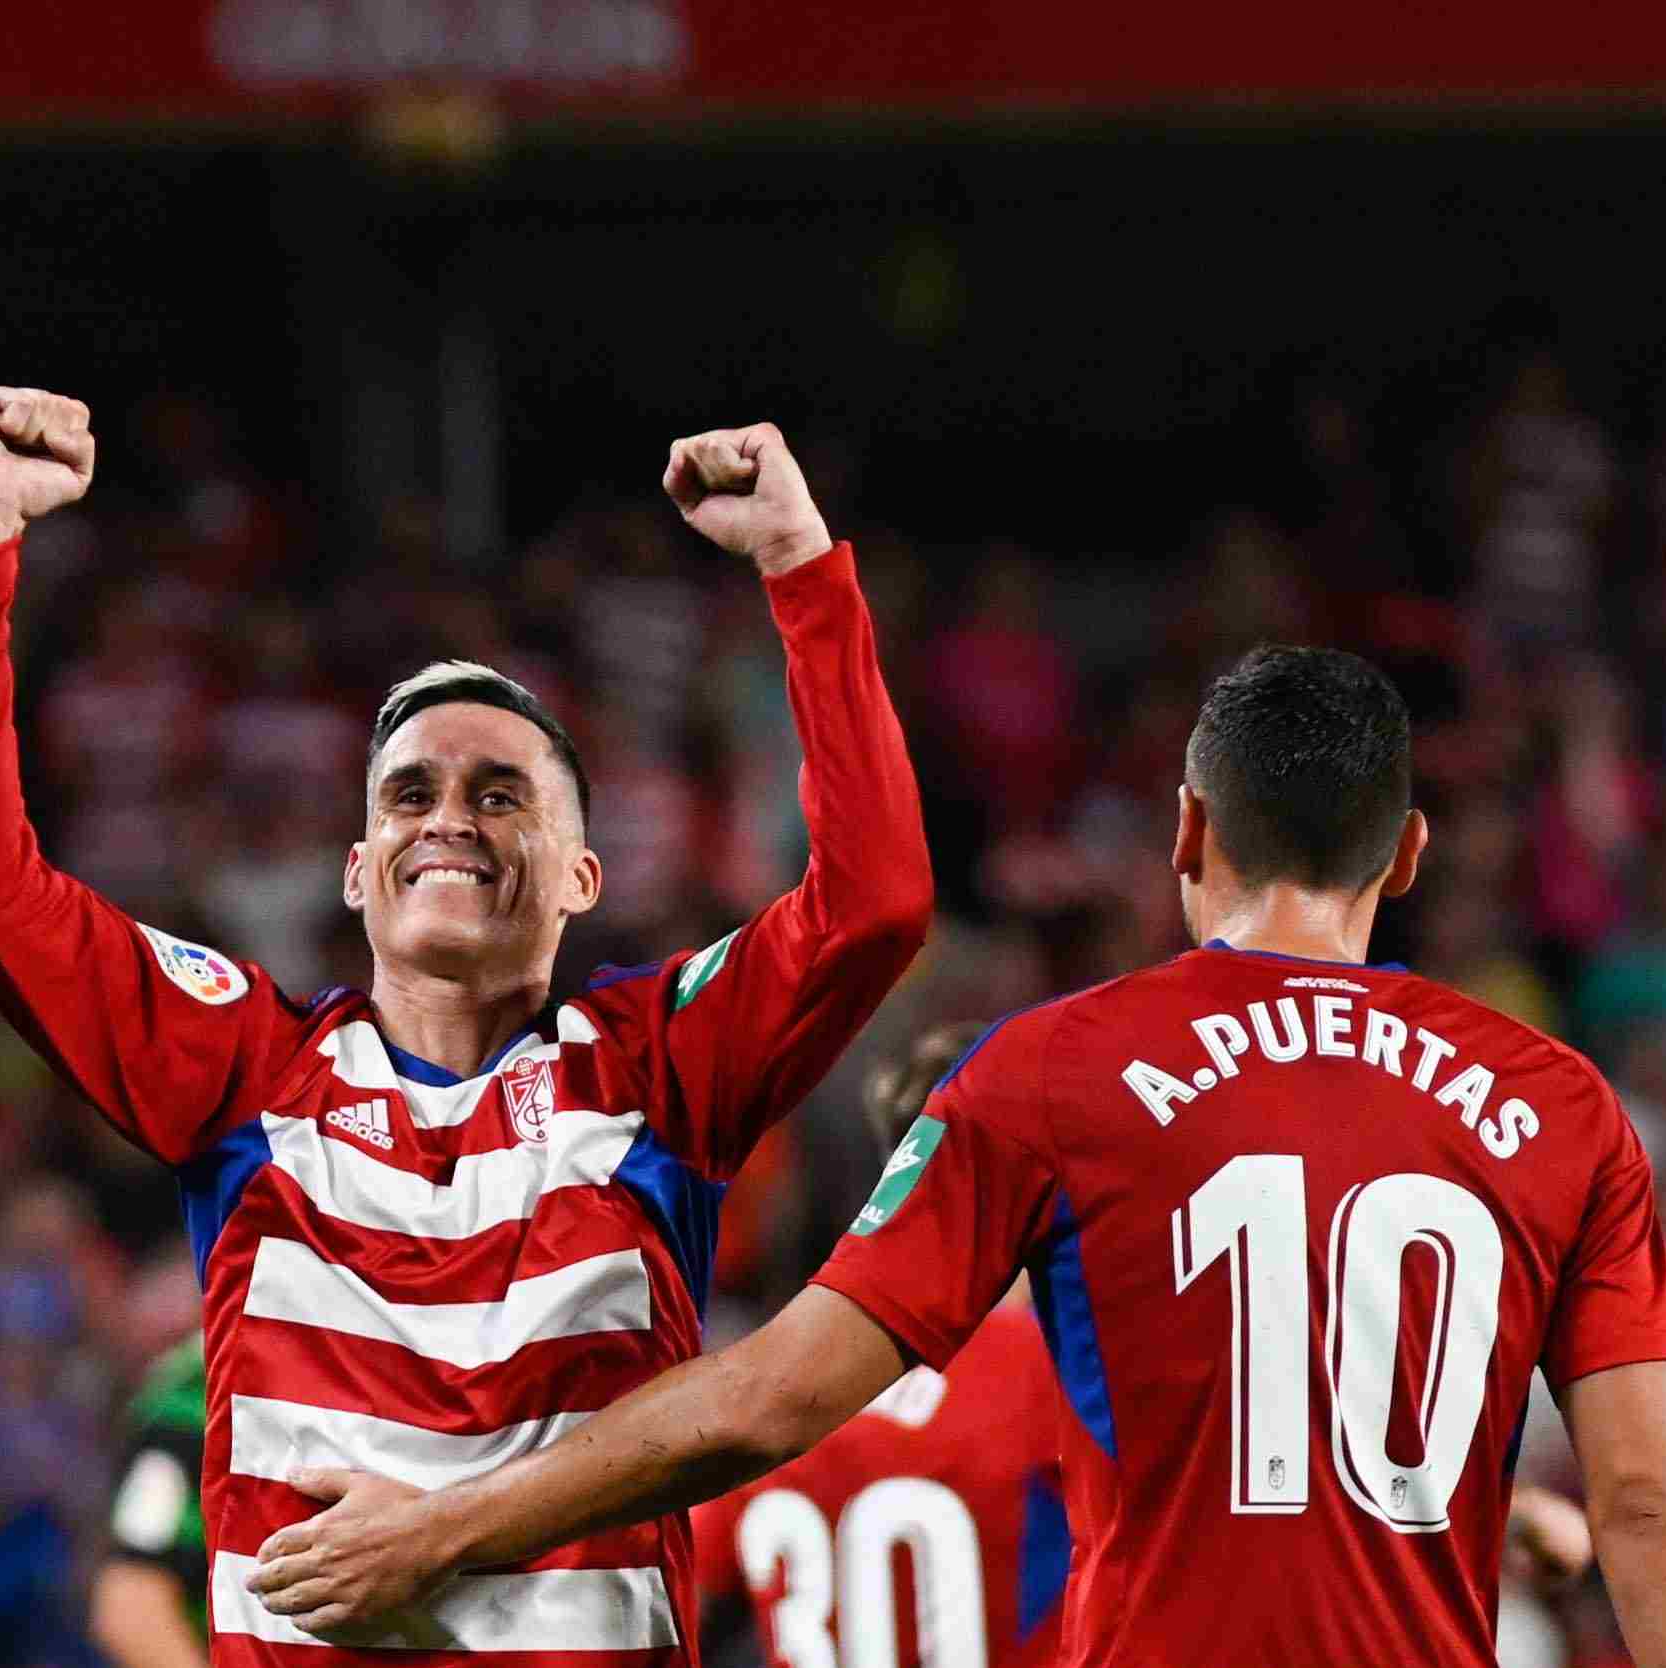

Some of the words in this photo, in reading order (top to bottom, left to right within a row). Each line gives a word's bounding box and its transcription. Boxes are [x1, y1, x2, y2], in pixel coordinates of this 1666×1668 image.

[325, 1110, 395, 1150] adidas
[1122, 995, 1540, 1160] A.PUERTAS
[1171, 1153, 1505, 1535] 10
